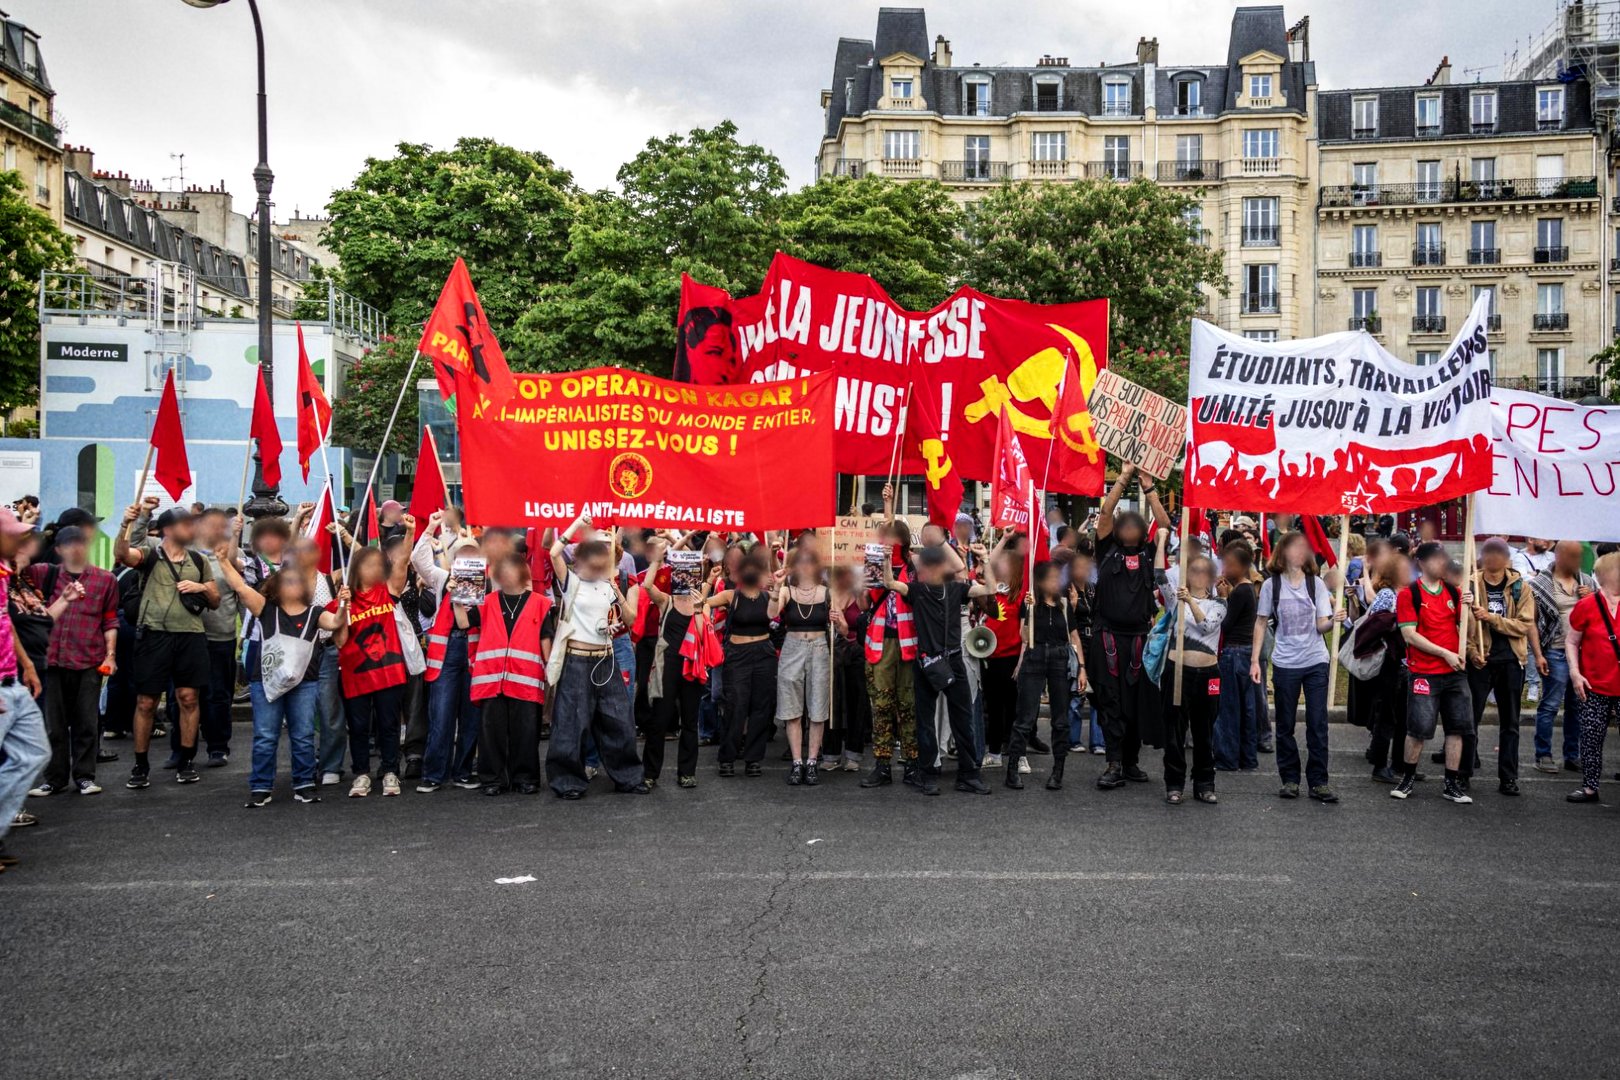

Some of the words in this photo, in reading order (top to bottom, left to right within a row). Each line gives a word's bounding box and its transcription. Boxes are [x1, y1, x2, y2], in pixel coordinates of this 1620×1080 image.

[779, 279, 812, 345] LA
[819, 294, 986, 366] JEUNESSE
[61, 346, 119, 358] Moderne
[1208, 344, 1344, 388] ÉTUDIANTS,
[561, 374, 698, 405] OPERATION
[706, 386, 793, 408] KAGAR
[1096, 373, 1119, 398] ALL
[1118, 381, 1145, 407] YOU
[1140, 391, 1164, 418] HAD
[1161, 400, 1179, 426] TO
[1198, 393, 1276, 428] UNITÉ
[1378, 406, 1412, 437] LA
[1421, 369, 1491, 430] VICTOIR
[472, 402, 645, 424] AI-IMPÉRIALISTES
[647, 406, 673, 426] DU
[676, 413, 747, 431] MONDE
[752, 408, 816, 431] ENTIER,
[1105, 400, 1133, 430] PAY
[1125, 409, 1147, 437] US
[1140, 417, 1184, 458] ENOUGH
[544, 427, 719, 456] UNISSEZ-VOUS
[730, 434, 738, 456] !
[1095, 423, 1148, 465] FUCKING
[1142, 448, 1174, 480] LIVE
[525, 502, 575, 517] LIGUE
[581, 501, 745, 526] ANTI-IMPÉRIALISTE
[1001, 505, 1029, 524] ÉTUD
[1341, 495, 1358, 506] FSE
[840, 519, 859, 528] CAN
